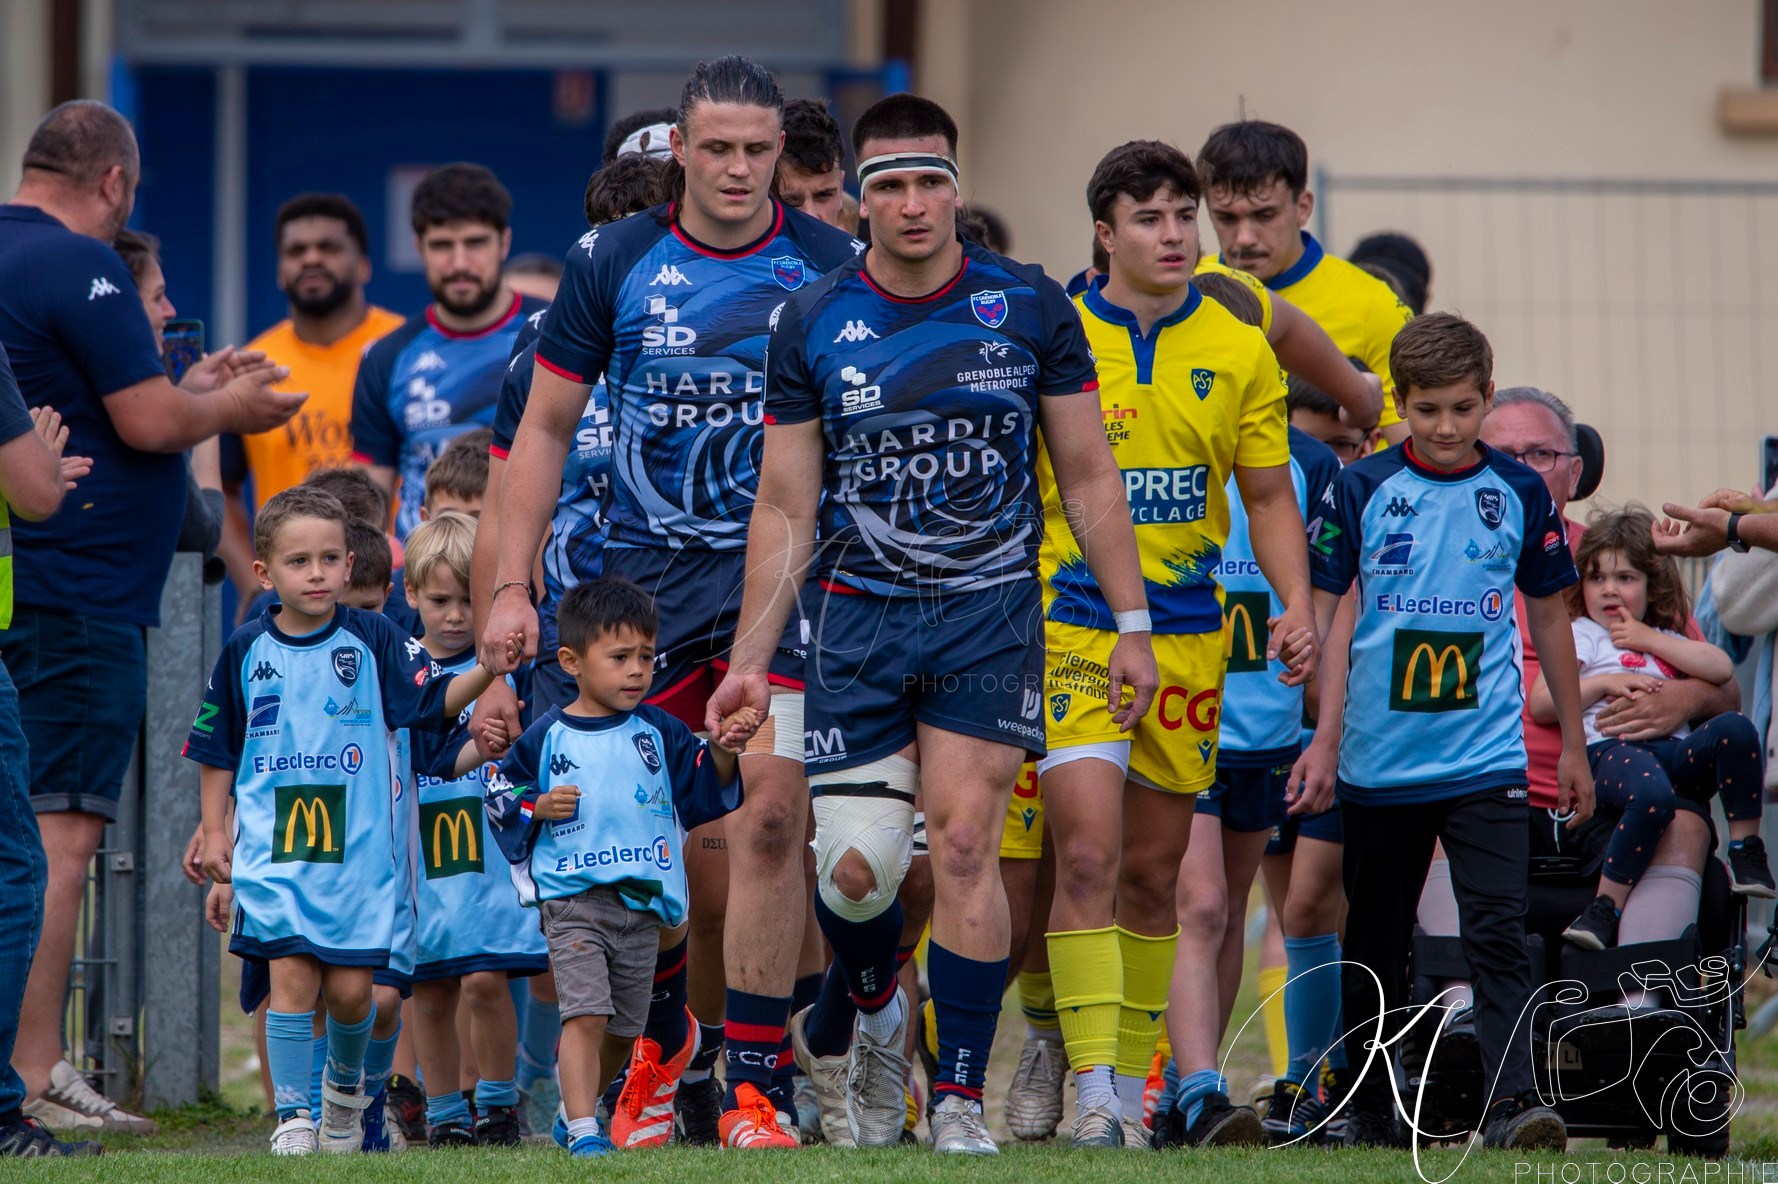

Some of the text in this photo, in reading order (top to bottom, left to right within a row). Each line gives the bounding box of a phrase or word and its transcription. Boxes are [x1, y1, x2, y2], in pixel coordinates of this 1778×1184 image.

[642, 326, 697, 348] SD
[642, 347, 696, 356] SERVICES
[646, 371, 764, 395] HARD
[970, 377, 1028, 393] MÉTROPOLE
[841, 385, 881, 407] SD
[843, 400, 882, 412] SERVICES
[846, 412, 1019, 454] HARDIS
[856, 449, 1001, 481] GROUP
[1125, 466, 1207, 502] PREC
[1372, 568, 1414, 576] CHAMBARD
[1376, 593, 1476, 616] E.Leclerc
[254, 752, 337, 774] E.Leclerc
[818, 755, 848, 764] GROUP
[555, 845, 653, 873] E.Leclerc
[726, 1049, 778, 1069] FCG
[954, 1048, 972, 1087] FCG
[450, 1128, 473, 1138] umbro
